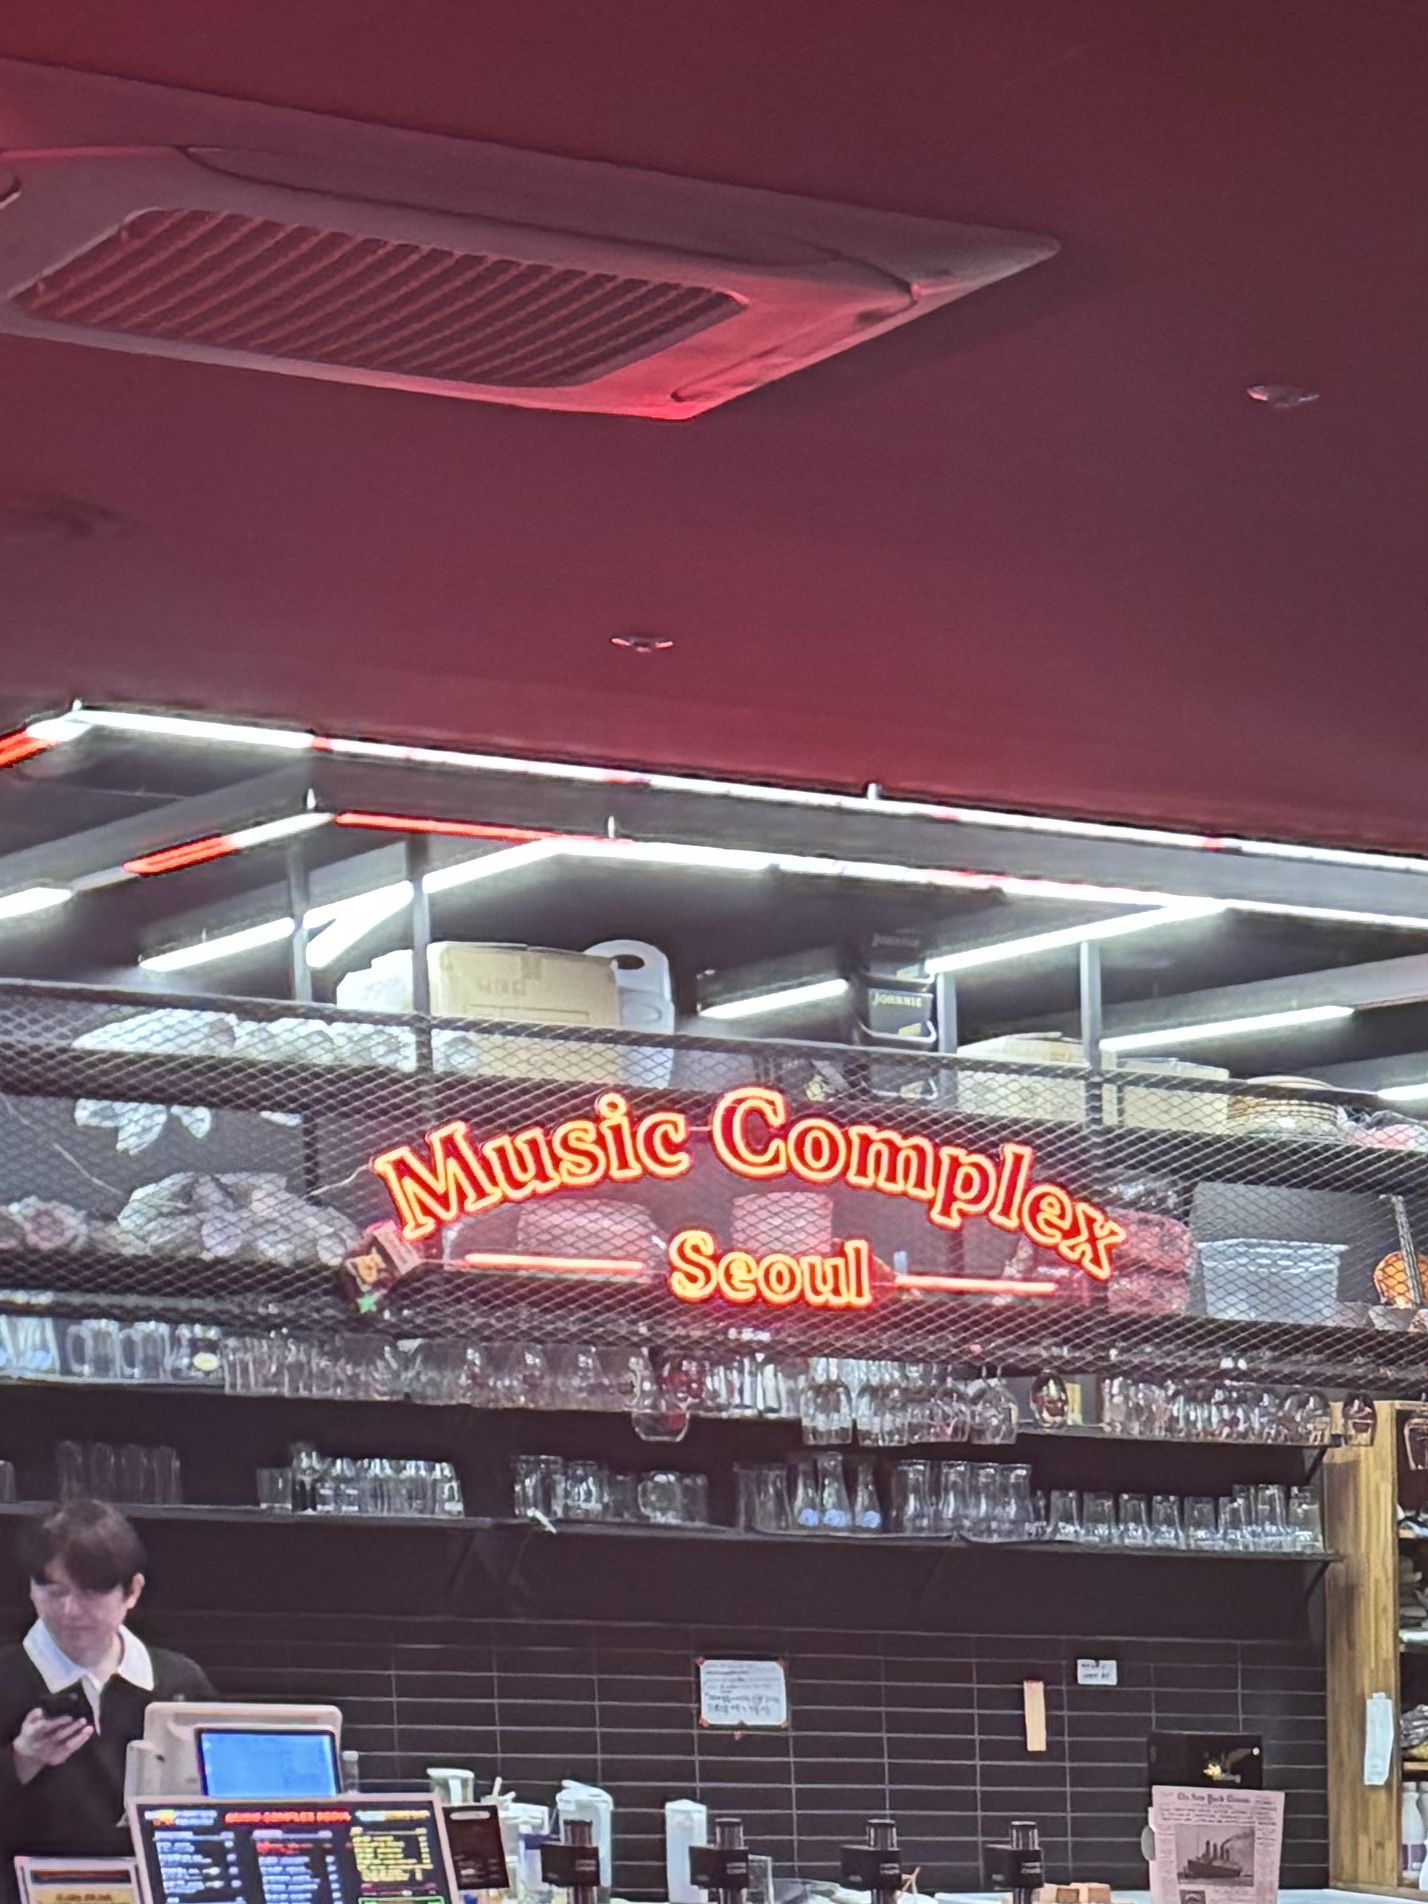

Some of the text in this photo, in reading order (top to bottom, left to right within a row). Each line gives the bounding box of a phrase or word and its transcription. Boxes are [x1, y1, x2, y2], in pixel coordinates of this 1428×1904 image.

[372, 1084, 1128, 1284] Music Complex
[668, 1228, 874, 1307] Seoul
